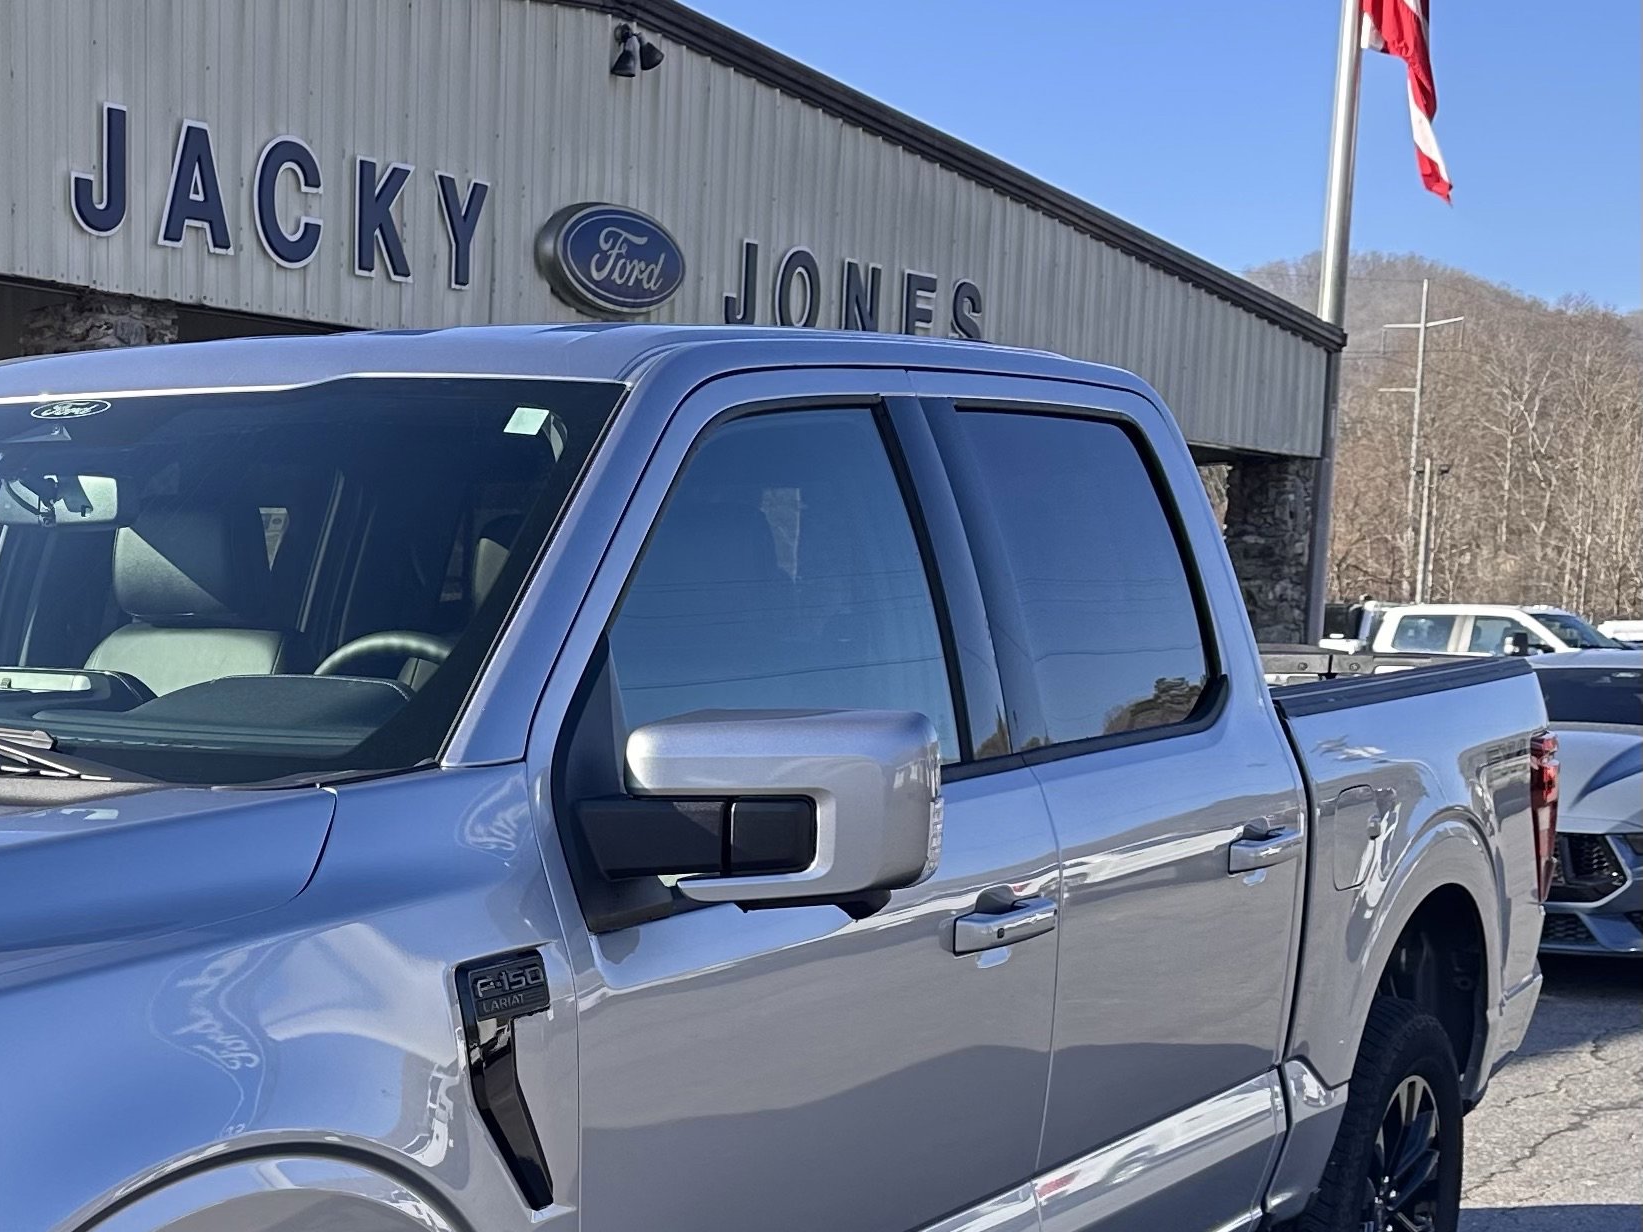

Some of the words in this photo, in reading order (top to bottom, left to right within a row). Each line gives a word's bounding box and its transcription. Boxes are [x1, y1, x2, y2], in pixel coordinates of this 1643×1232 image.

[70, 101, 490, 290] JACKY
[723, 238, 983, 341] JONES
[590, 226, 666, 291] Ford
[477, 966, 544, 998] F-150
[482, 994, 525, 1013] LARIAT
